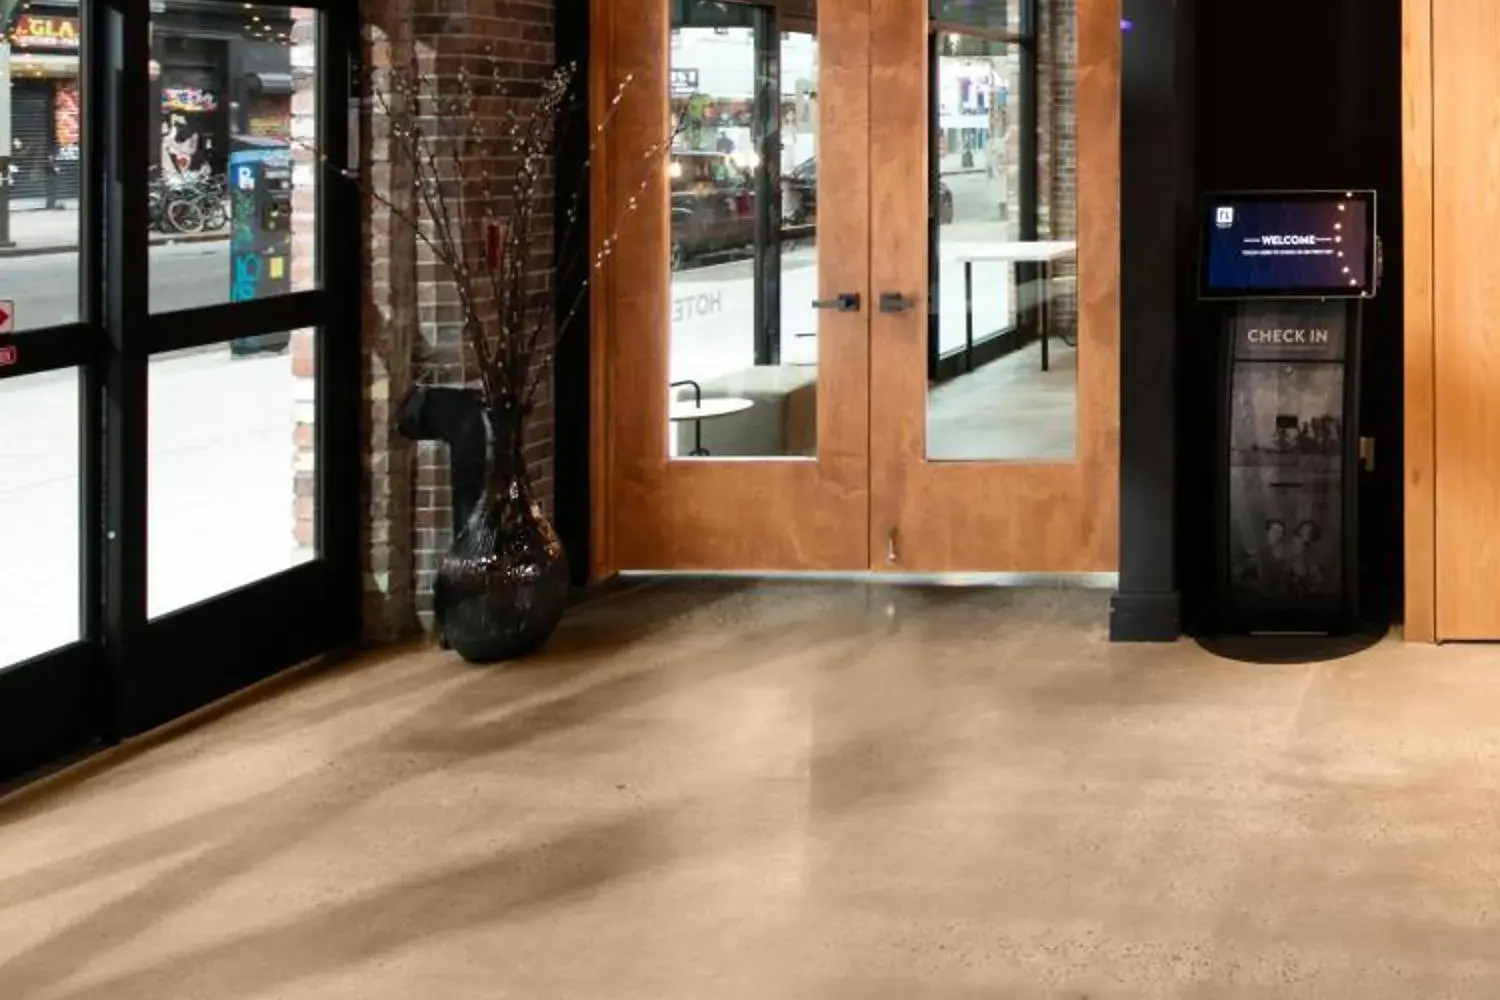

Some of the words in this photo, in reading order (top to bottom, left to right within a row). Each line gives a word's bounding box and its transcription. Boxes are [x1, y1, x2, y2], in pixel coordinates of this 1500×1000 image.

[1261, 235, 1316, 246] WELCOME
[1247, 329, 1305, 344] CHECK
[1310, 329, 1329, 343] IN
